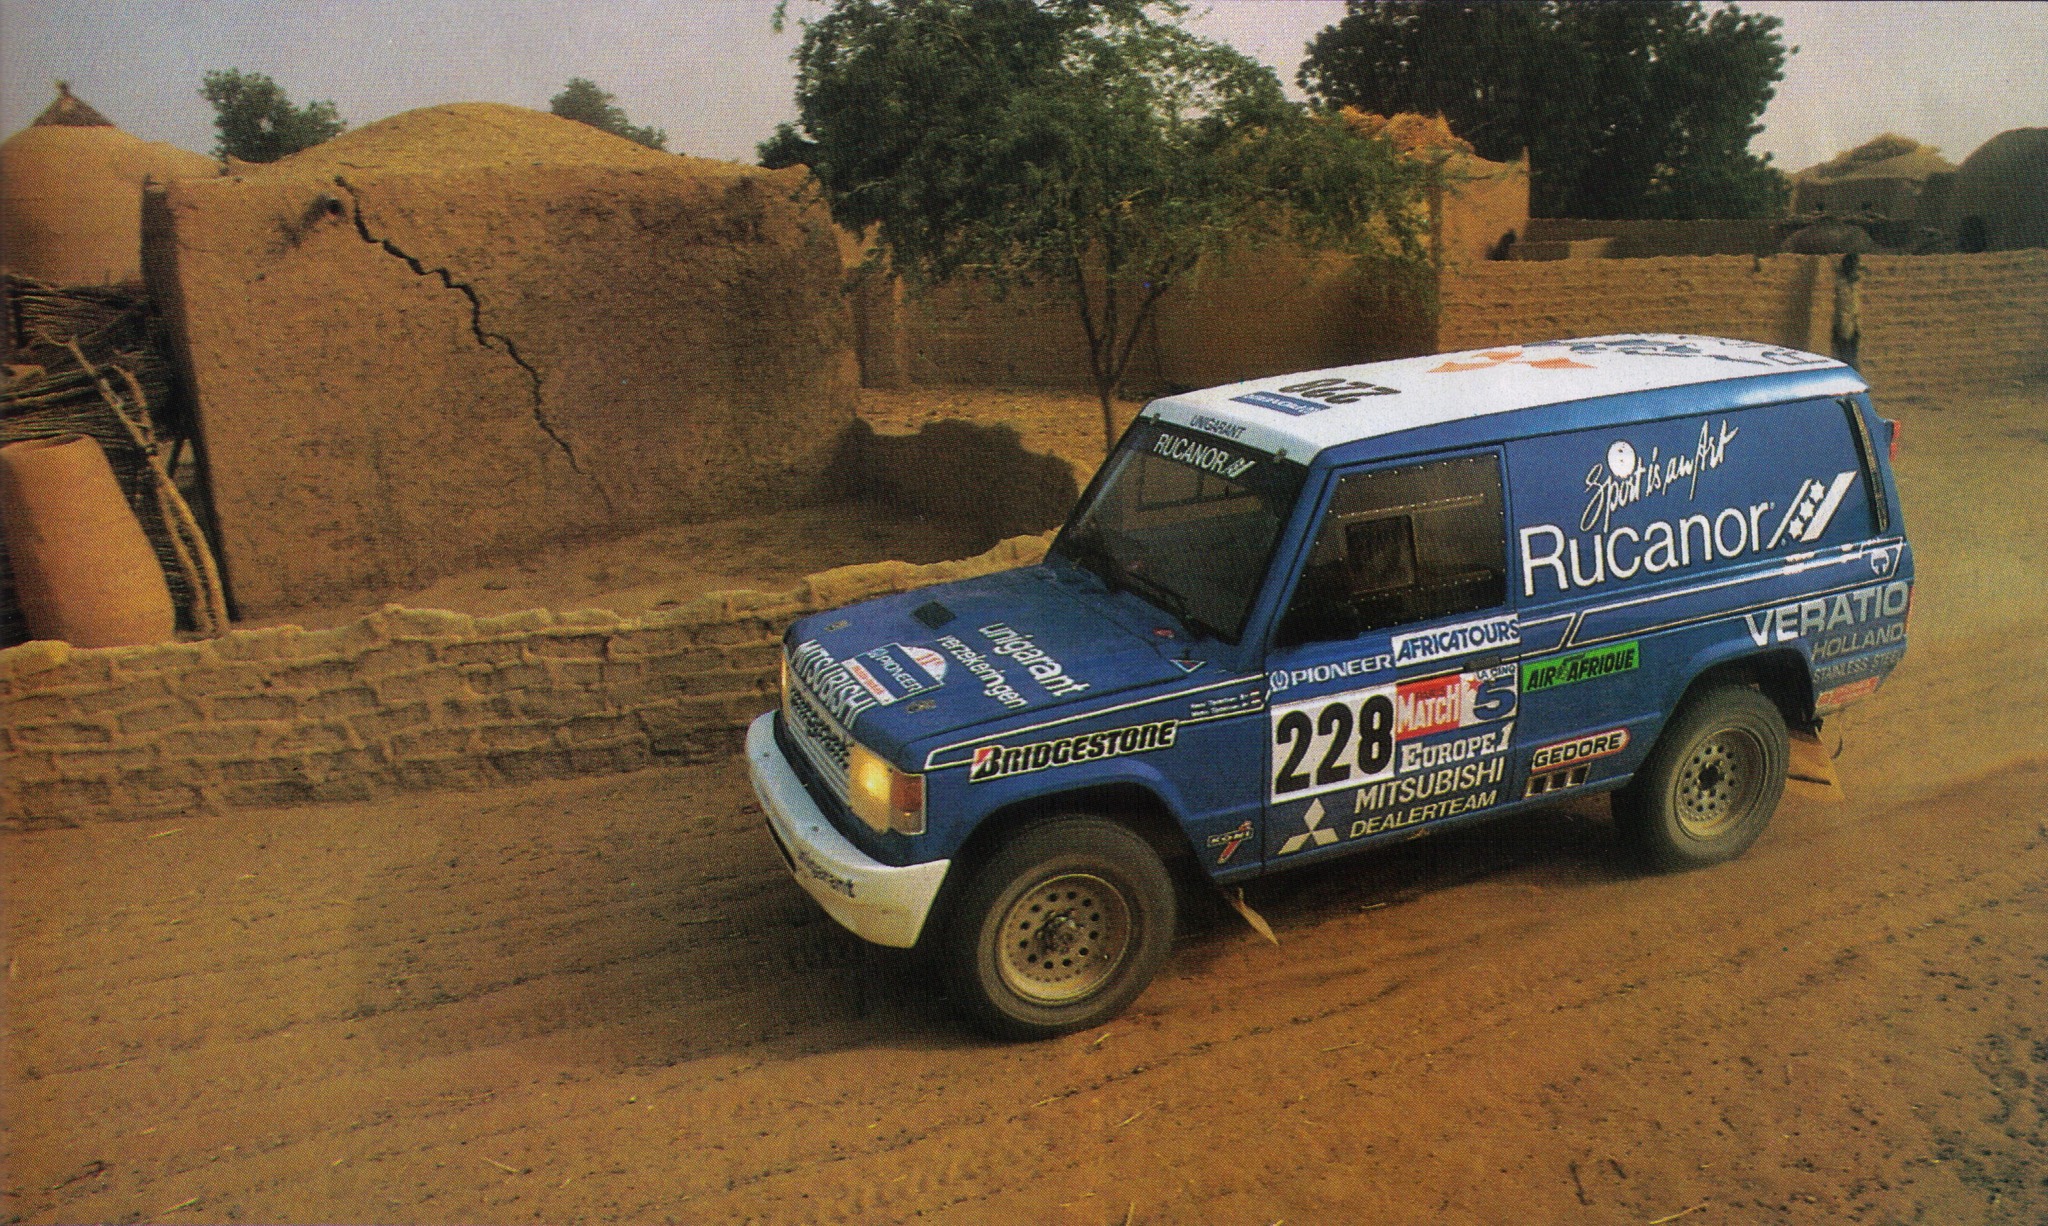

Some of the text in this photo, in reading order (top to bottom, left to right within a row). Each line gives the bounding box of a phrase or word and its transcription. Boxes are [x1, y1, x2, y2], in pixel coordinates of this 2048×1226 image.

[1153, 433, 1229, 474] RUCANOR
[1646, 446, 1661, 497] is
[1689, 419, 1739, 500] Art
[1519, 502, 1769, 597] Rucanor
[1744, 580, 1908, 646] VERATIO
[978, 622, 1091, 697] unigarant
[1396, 618, 1520, 663] AFRICATOURS
[1810, 622, 1904, 662] HOLLAND
[877, 655, 923, 693] PIONEER
[1291, 654, 1391, 686] PIONEER
[1527, 648, 1635, 691] AIR AFRIQUE
[1397, 683, 1460, 733] MATCH
[1473, 675, 1517, 720] 5
[970, 720, 1177, 780] BRIDGESTONE
[1275, 694, 1394, 794] 228
[1534, 732, 1622, 767] GEDORE
[1354, 756, 1505, 814] MITSUBISHI
[1350, 800, 1497, 838] DEALERTEAM
